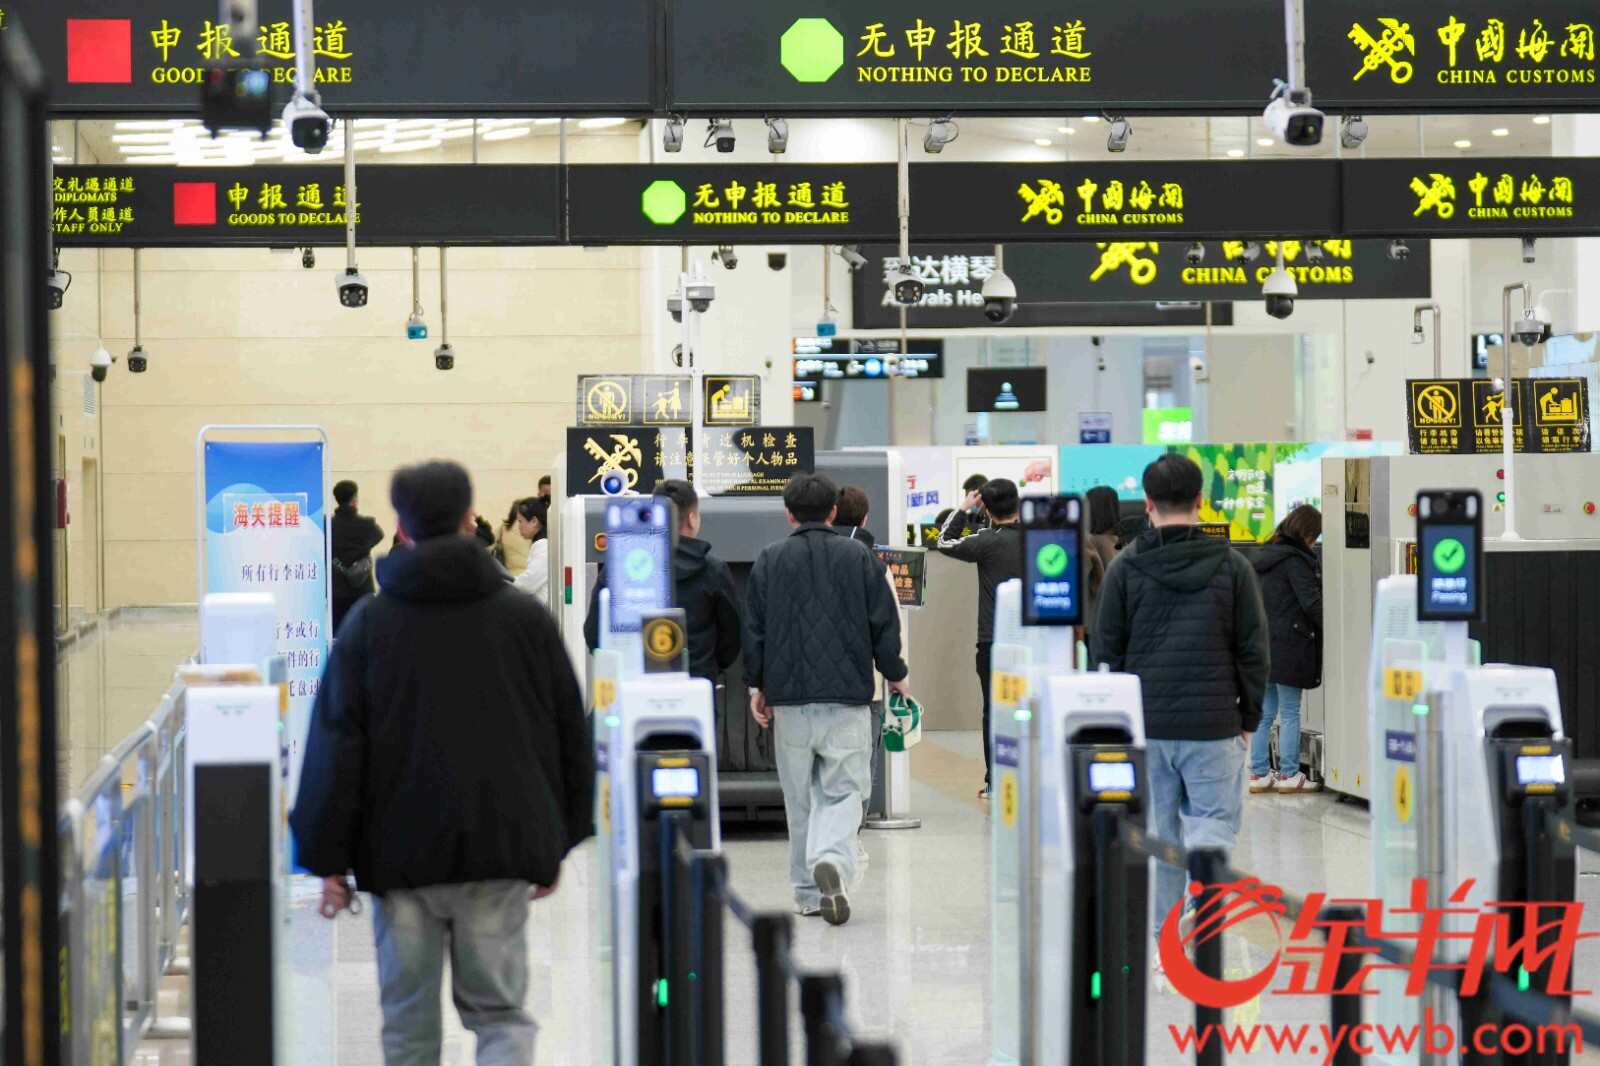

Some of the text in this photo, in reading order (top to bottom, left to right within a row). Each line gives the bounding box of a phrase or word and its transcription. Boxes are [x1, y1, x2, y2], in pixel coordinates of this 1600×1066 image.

[151, 19, 352, 62] 申报通道
[856, 18, 1092, 61] 无申报通道
[857, 66, 1091, 82] NOTHING TO DECLARE
[1437, 68, 1595, 83] CHINA CUSTOMS
[54, 192, 117, 202] DIPLOMATS
[693, 180, 849, 210] 无申报通道
[229, 213, 360, 224] GOODS TO DECLAE
[693, 212, 849, 224] NOTHING TO DECLARE
[1077, 213, 1184, 224] CHINA CUSTOMS
[1468, 206, 1573, 218] CHINA CUSTOMS
[89, 223, 123, 232] ONLY
[1182, 266, 1353, 284] CHINA CSTOMS
[233, 503, 301, 527] 海关提醒
[242, 563, 318, 583] 所有行李请过
[652, 624, 673, 651] 6
